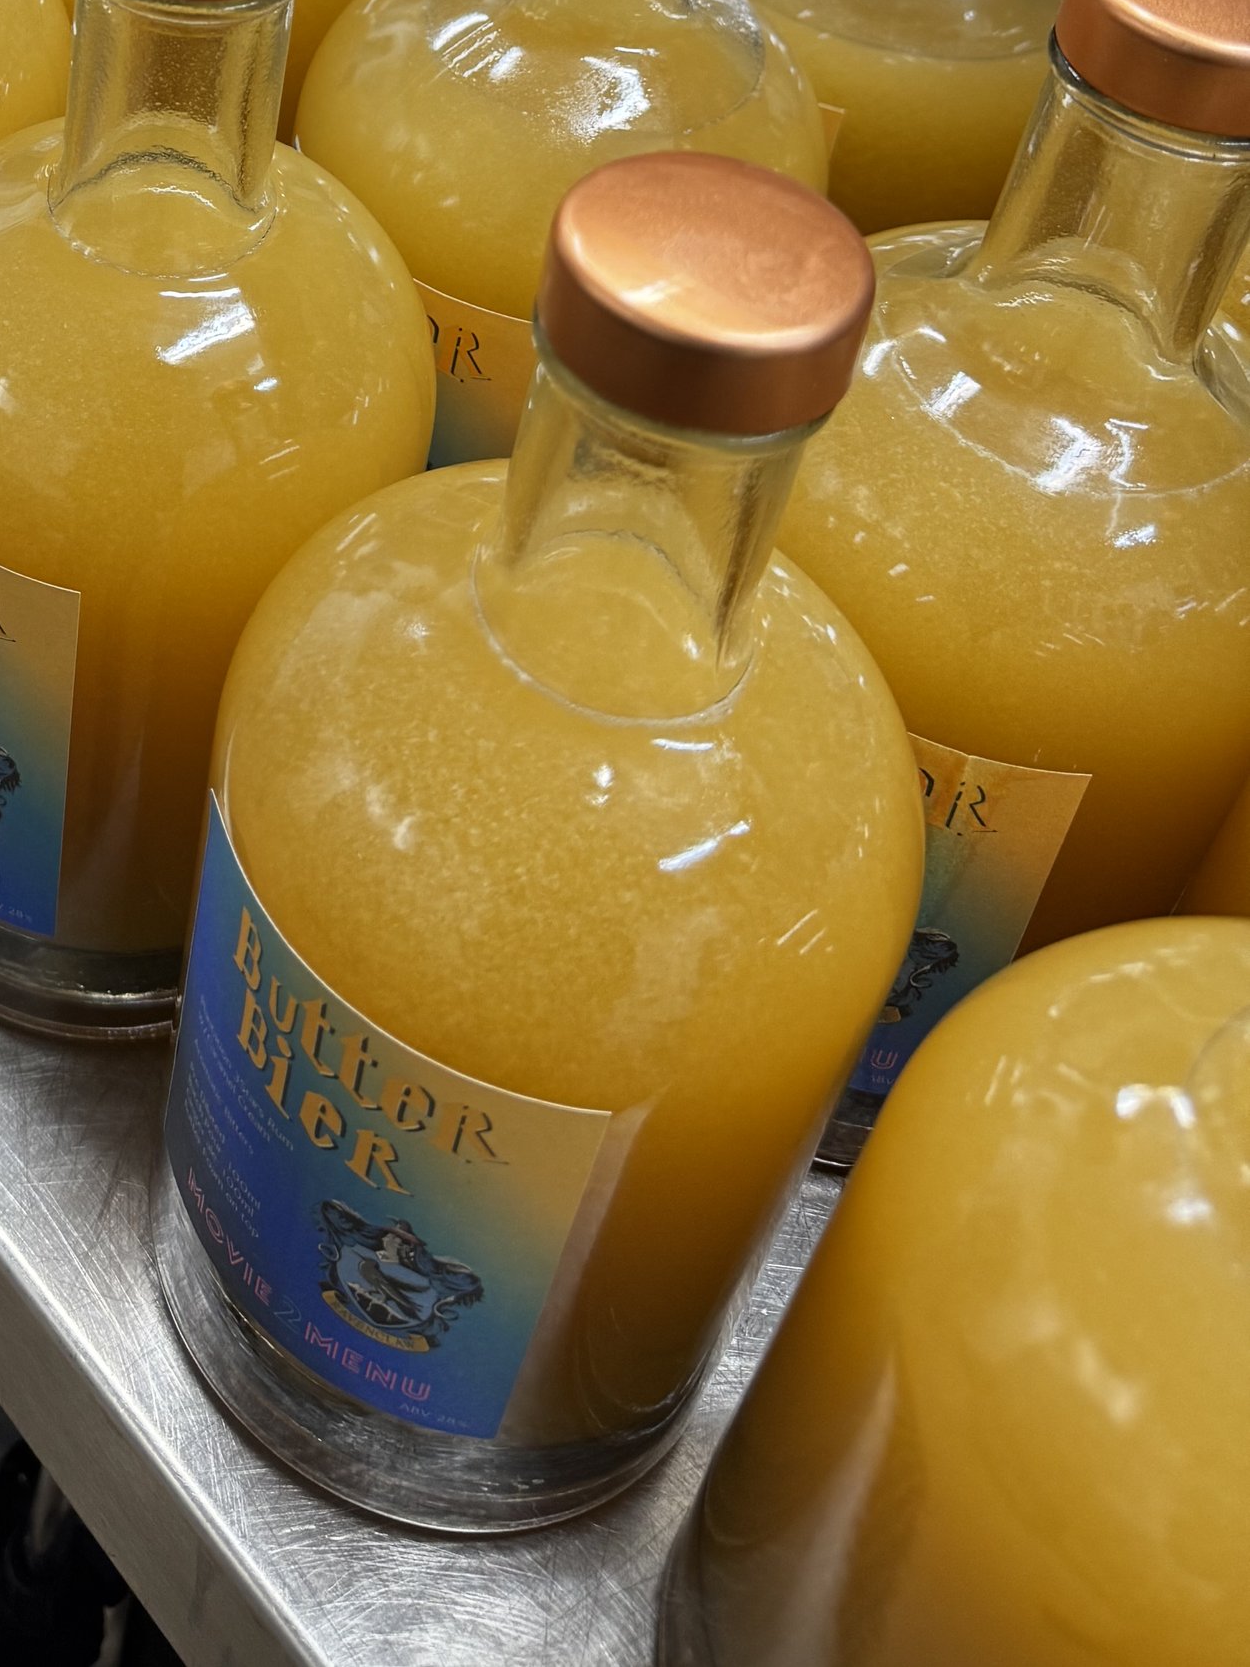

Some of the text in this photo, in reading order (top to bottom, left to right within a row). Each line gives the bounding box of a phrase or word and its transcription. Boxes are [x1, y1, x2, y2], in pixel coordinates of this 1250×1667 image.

[233, 907, 509, 1167] Butter
[236, 987, 415, 1197] Bier
[186, 1165, 432, 1402] MOVIE 2 MENU
